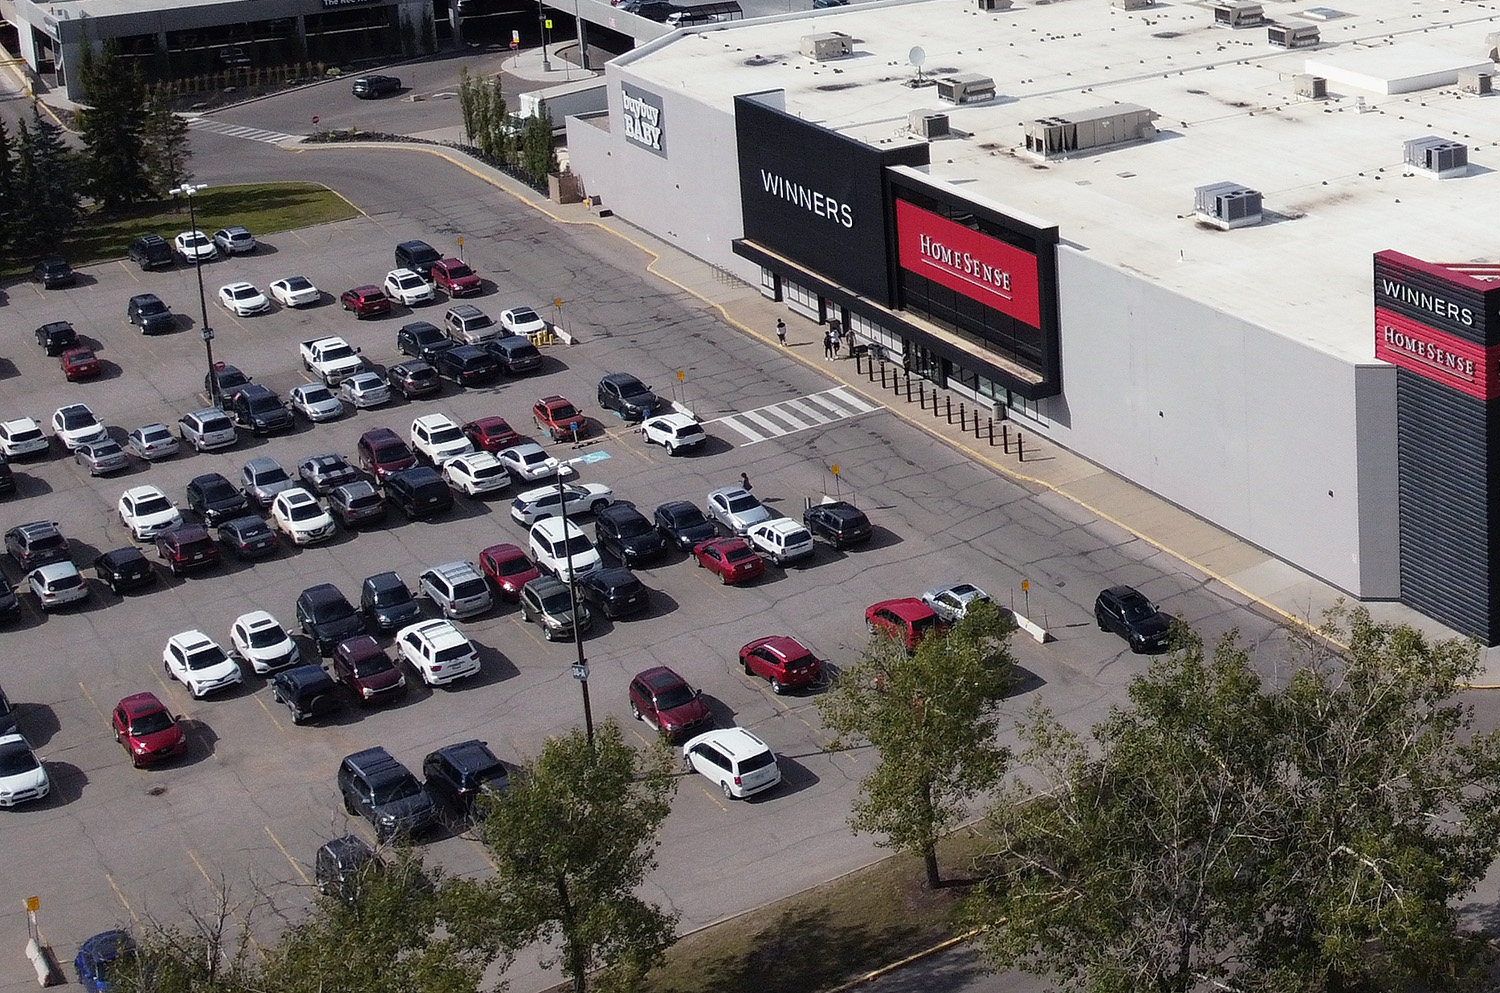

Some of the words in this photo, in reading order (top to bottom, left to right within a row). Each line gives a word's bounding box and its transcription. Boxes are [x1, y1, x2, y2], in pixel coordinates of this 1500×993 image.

[622, 90, 659, 127] buybuy
[624, 113, 661, 150] BABY
[761, 169, 853, 228] WINNERS
[1382, 279, 1473, 326] WINNERS
